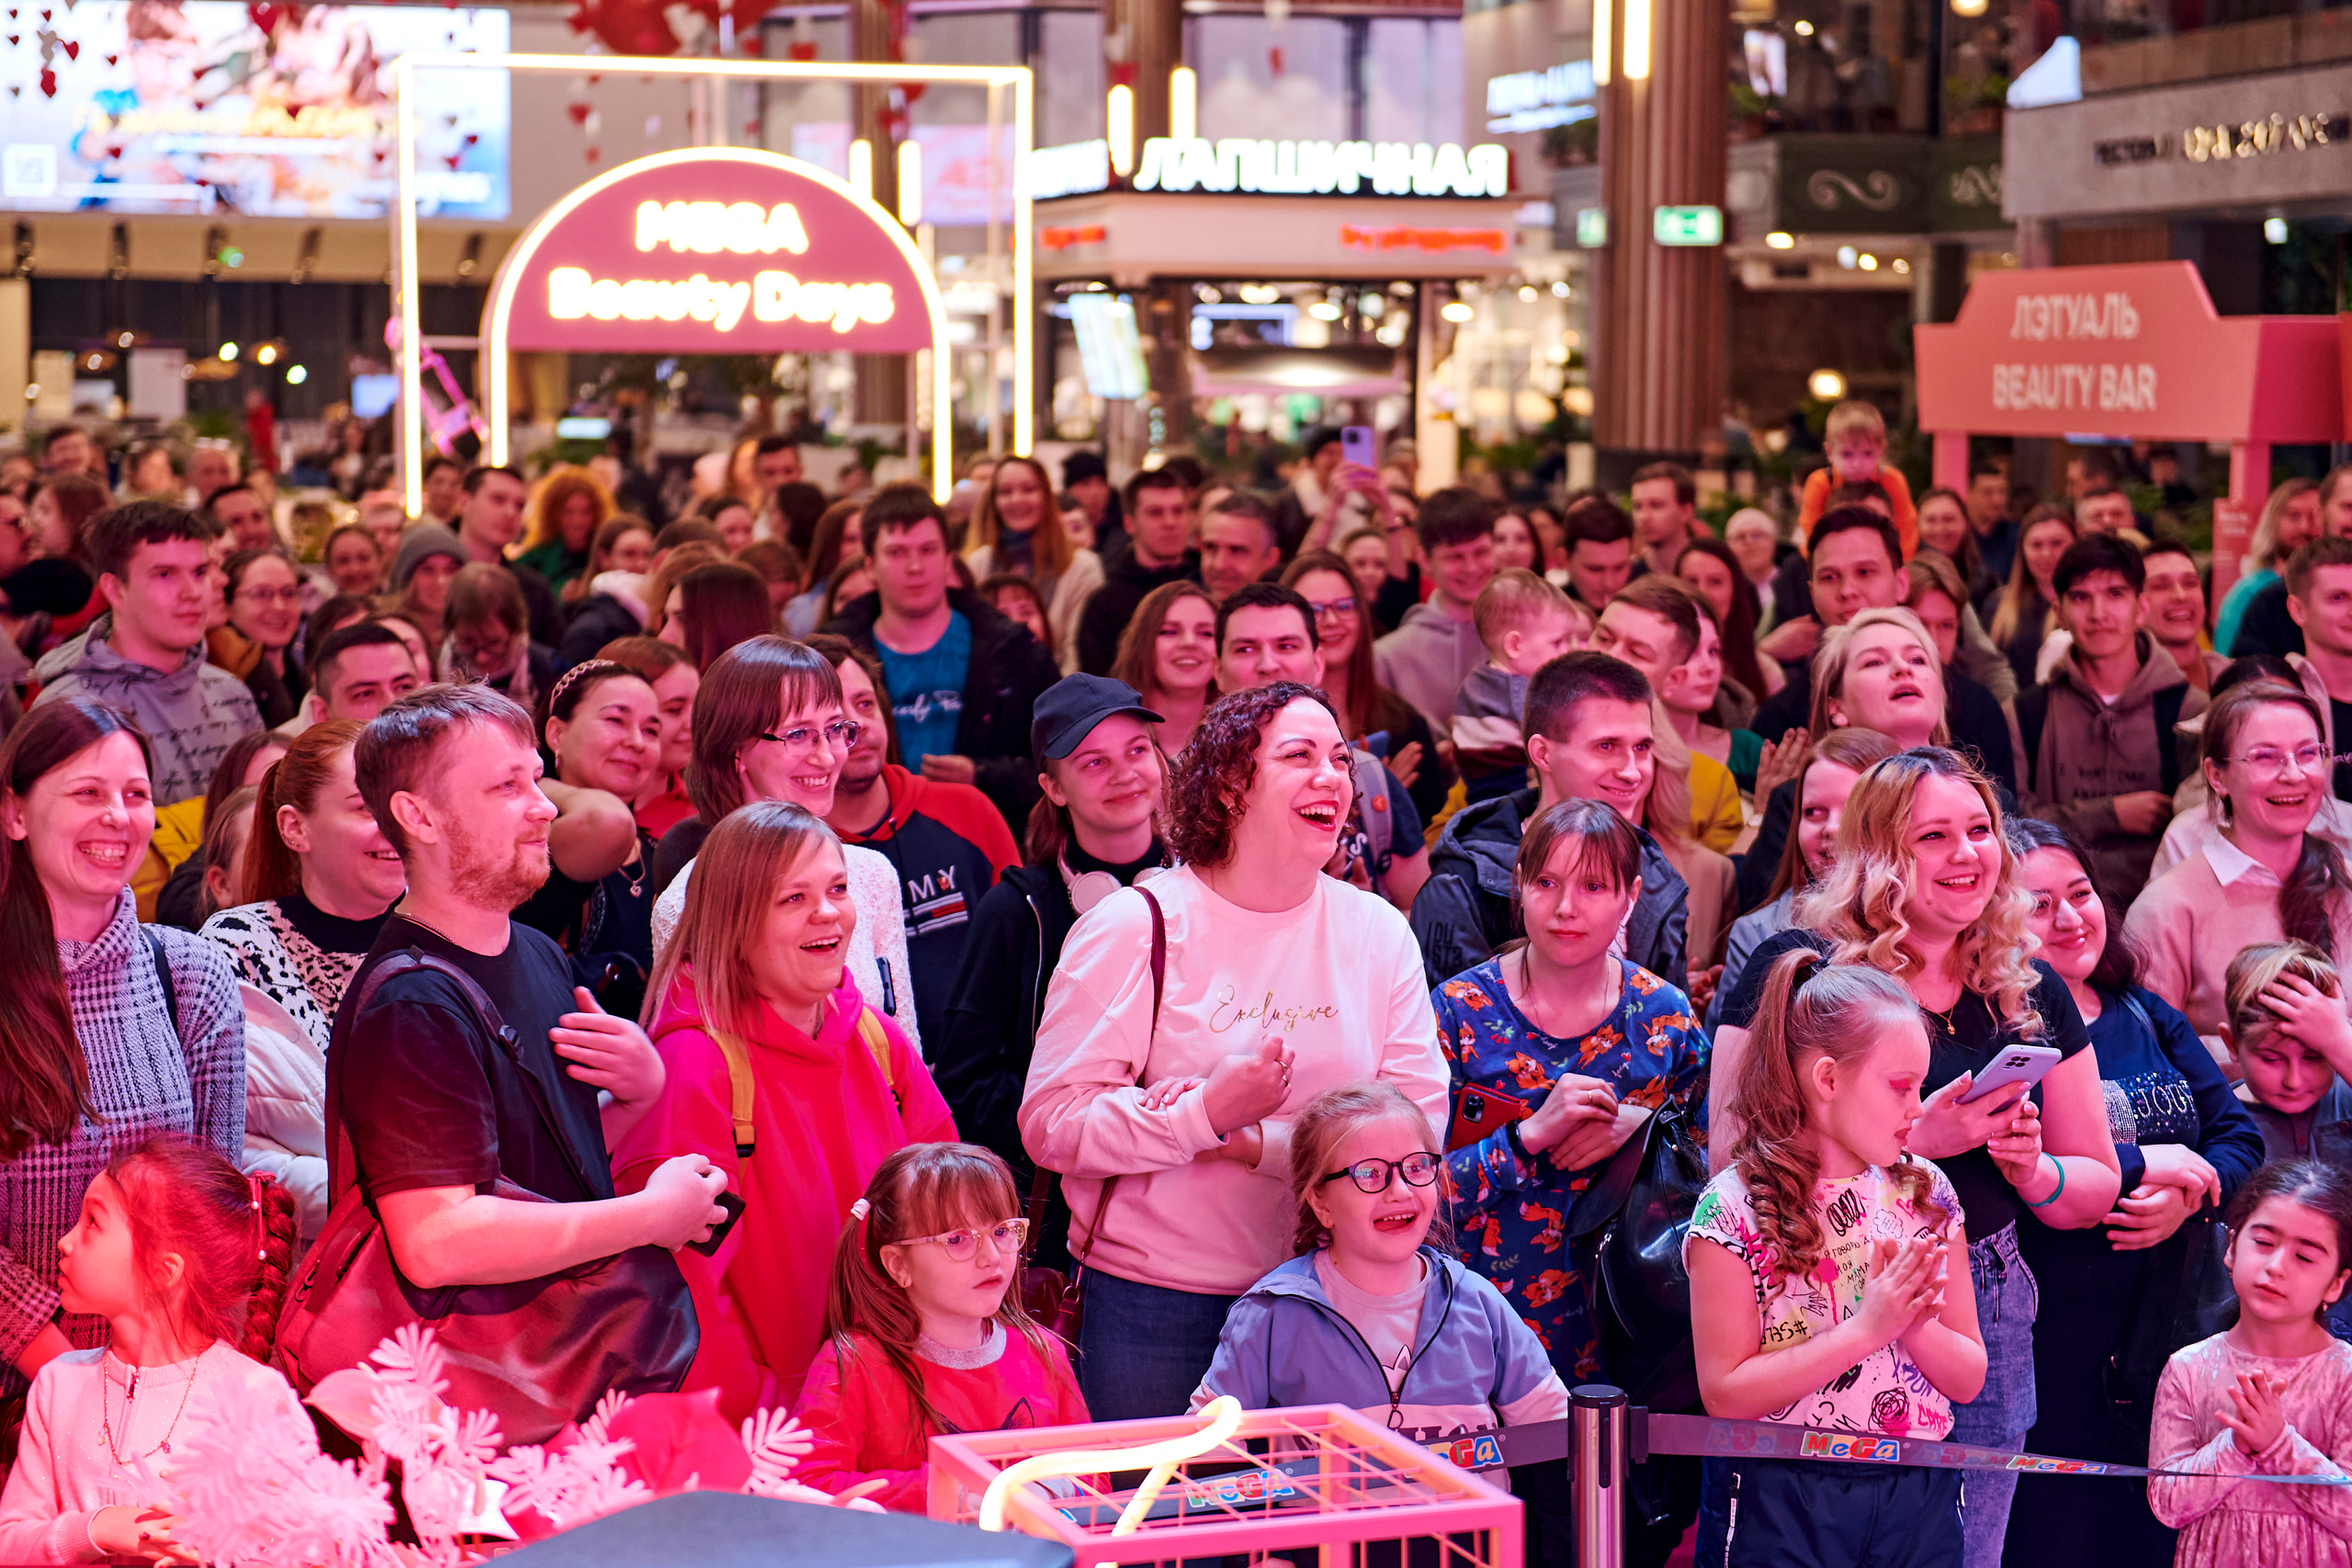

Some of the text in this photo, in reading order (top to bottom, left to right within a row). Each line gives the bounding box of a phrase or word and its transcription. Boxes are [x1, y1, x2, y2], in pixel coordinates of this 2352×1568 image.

[1133, 137, 1509, 197] ЛАПШИЧНАЯ
[635, 200, 809, 255] MEGA
[548, 266, 895, 333] Beauty Days
[2010, 291, 2141, 341] ЛЭТУАЛЬ
[1993, 364, 2157, 412] BEAUTY BAR
[1209, 985, 1340, 1033] Exclusive
[1834, 1260, 1854, 1277] МОЯ
